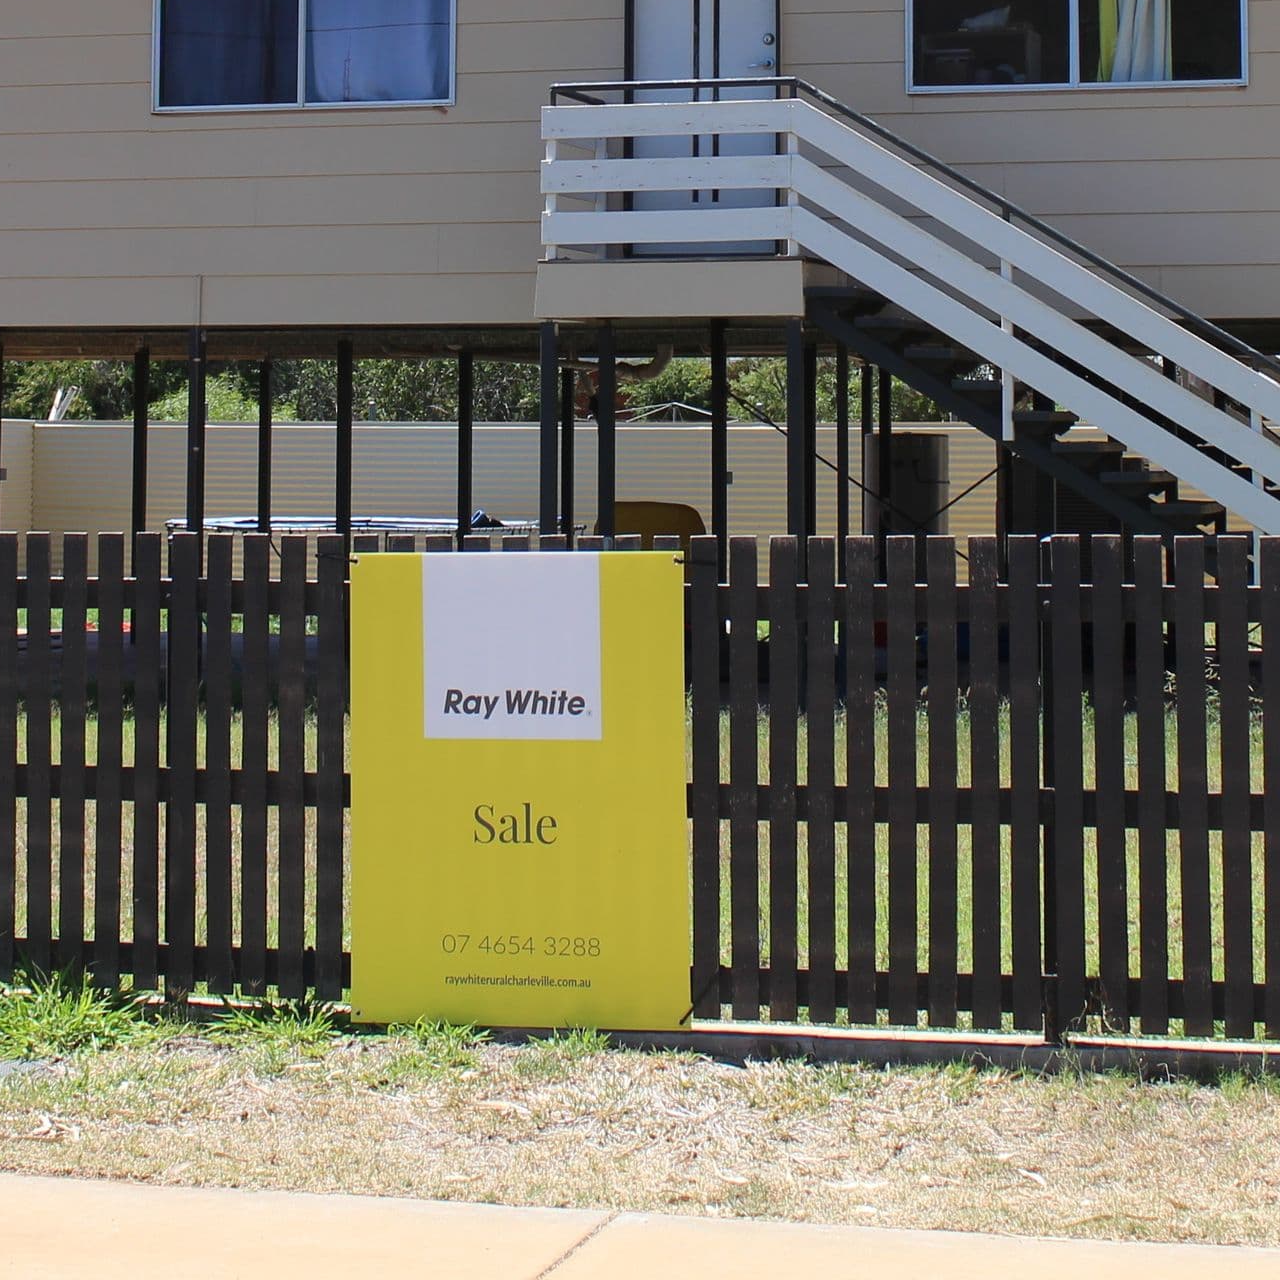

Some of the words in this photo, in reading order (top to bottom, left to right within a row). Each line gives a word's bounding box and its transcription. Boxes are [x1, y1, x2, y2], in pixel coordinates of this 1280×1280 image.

[443, 688, 499, 720] Ray
[505, 688, 586, 716] White
[472, 802, 558, 845] Sale
[441, 934, 471, 954] 07
[478, 935, 536, 955] 4654
[543, 936, 601, 957] 3288
[444, 973, 591, 988] raywhiteruralcharleville.com.au
